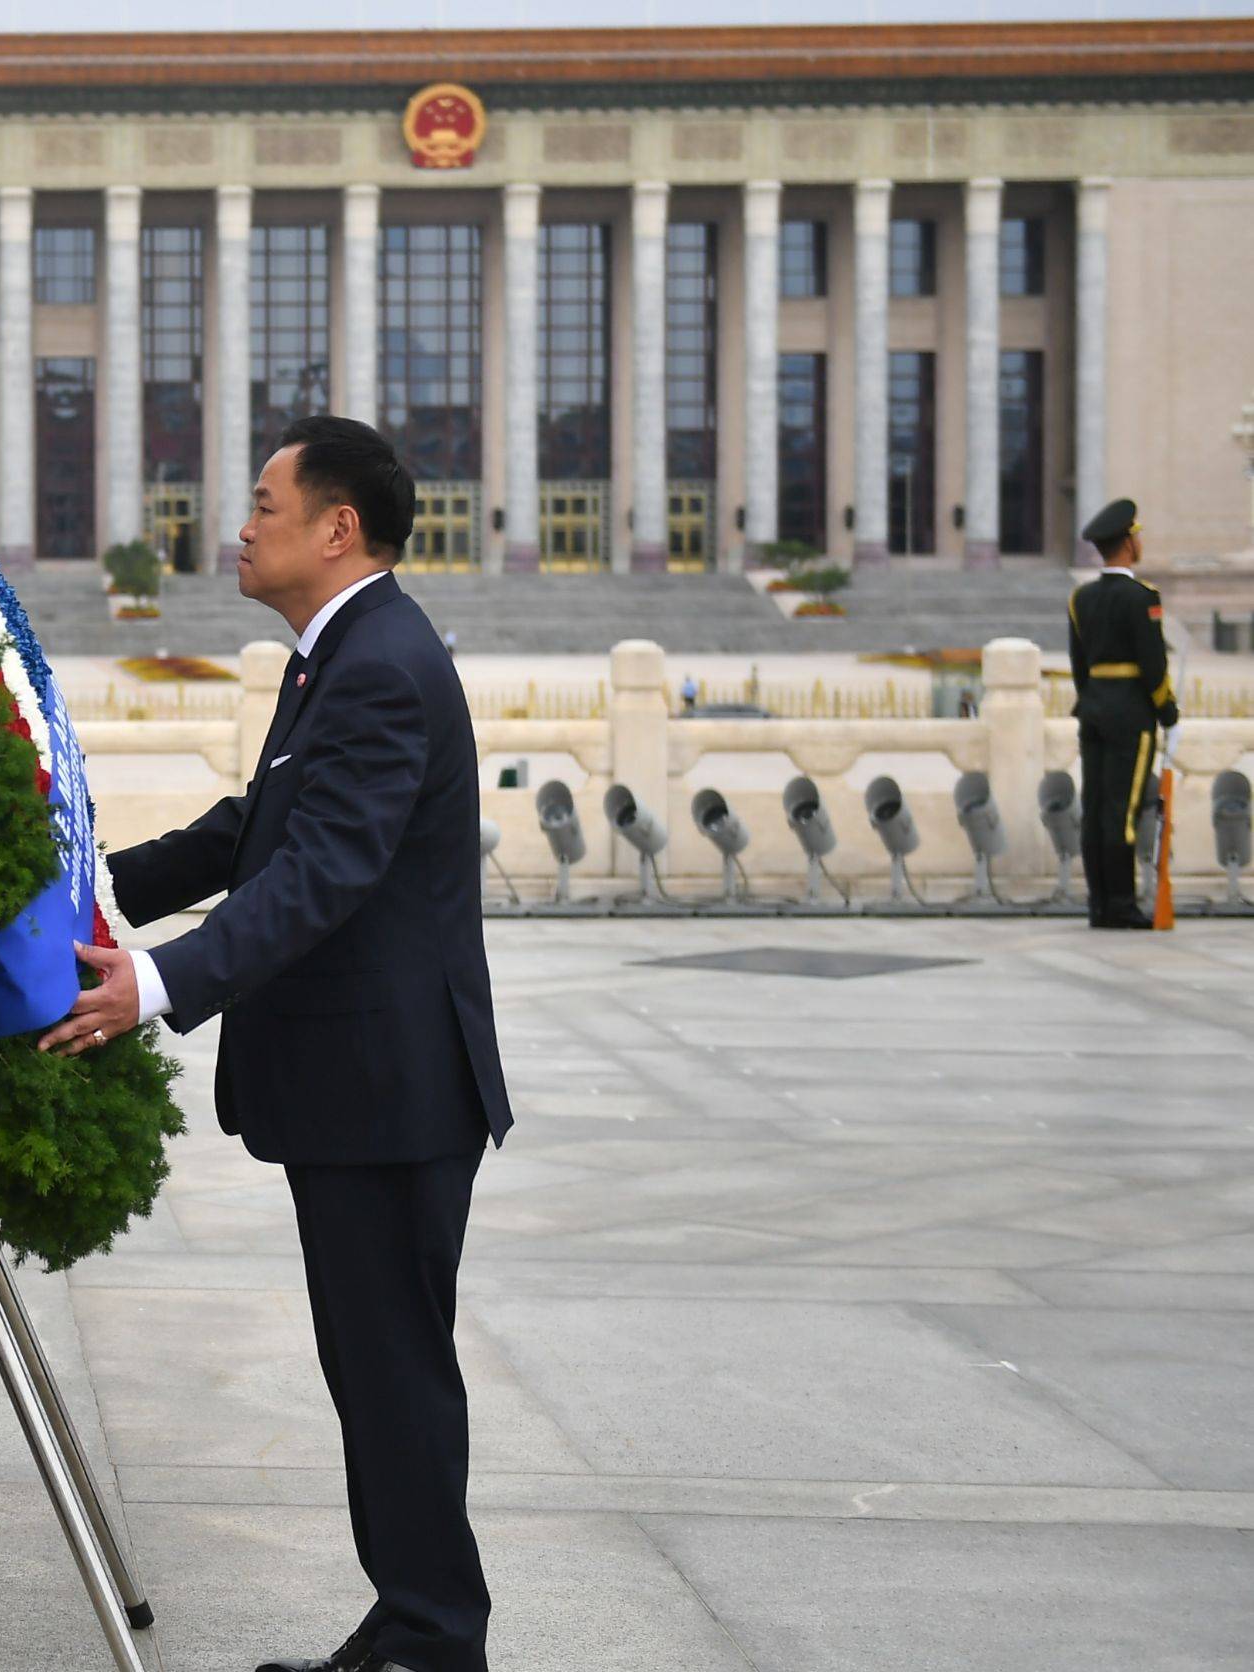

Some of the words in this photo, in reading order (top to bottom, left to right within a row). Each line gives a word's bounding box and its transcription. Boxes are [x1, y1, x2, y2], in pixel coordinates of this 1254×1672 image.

[57, 748, 72, 810] MR.
[70, 739, 83, 845] MINISTER
[70, 835, 82, 914] PRIME
